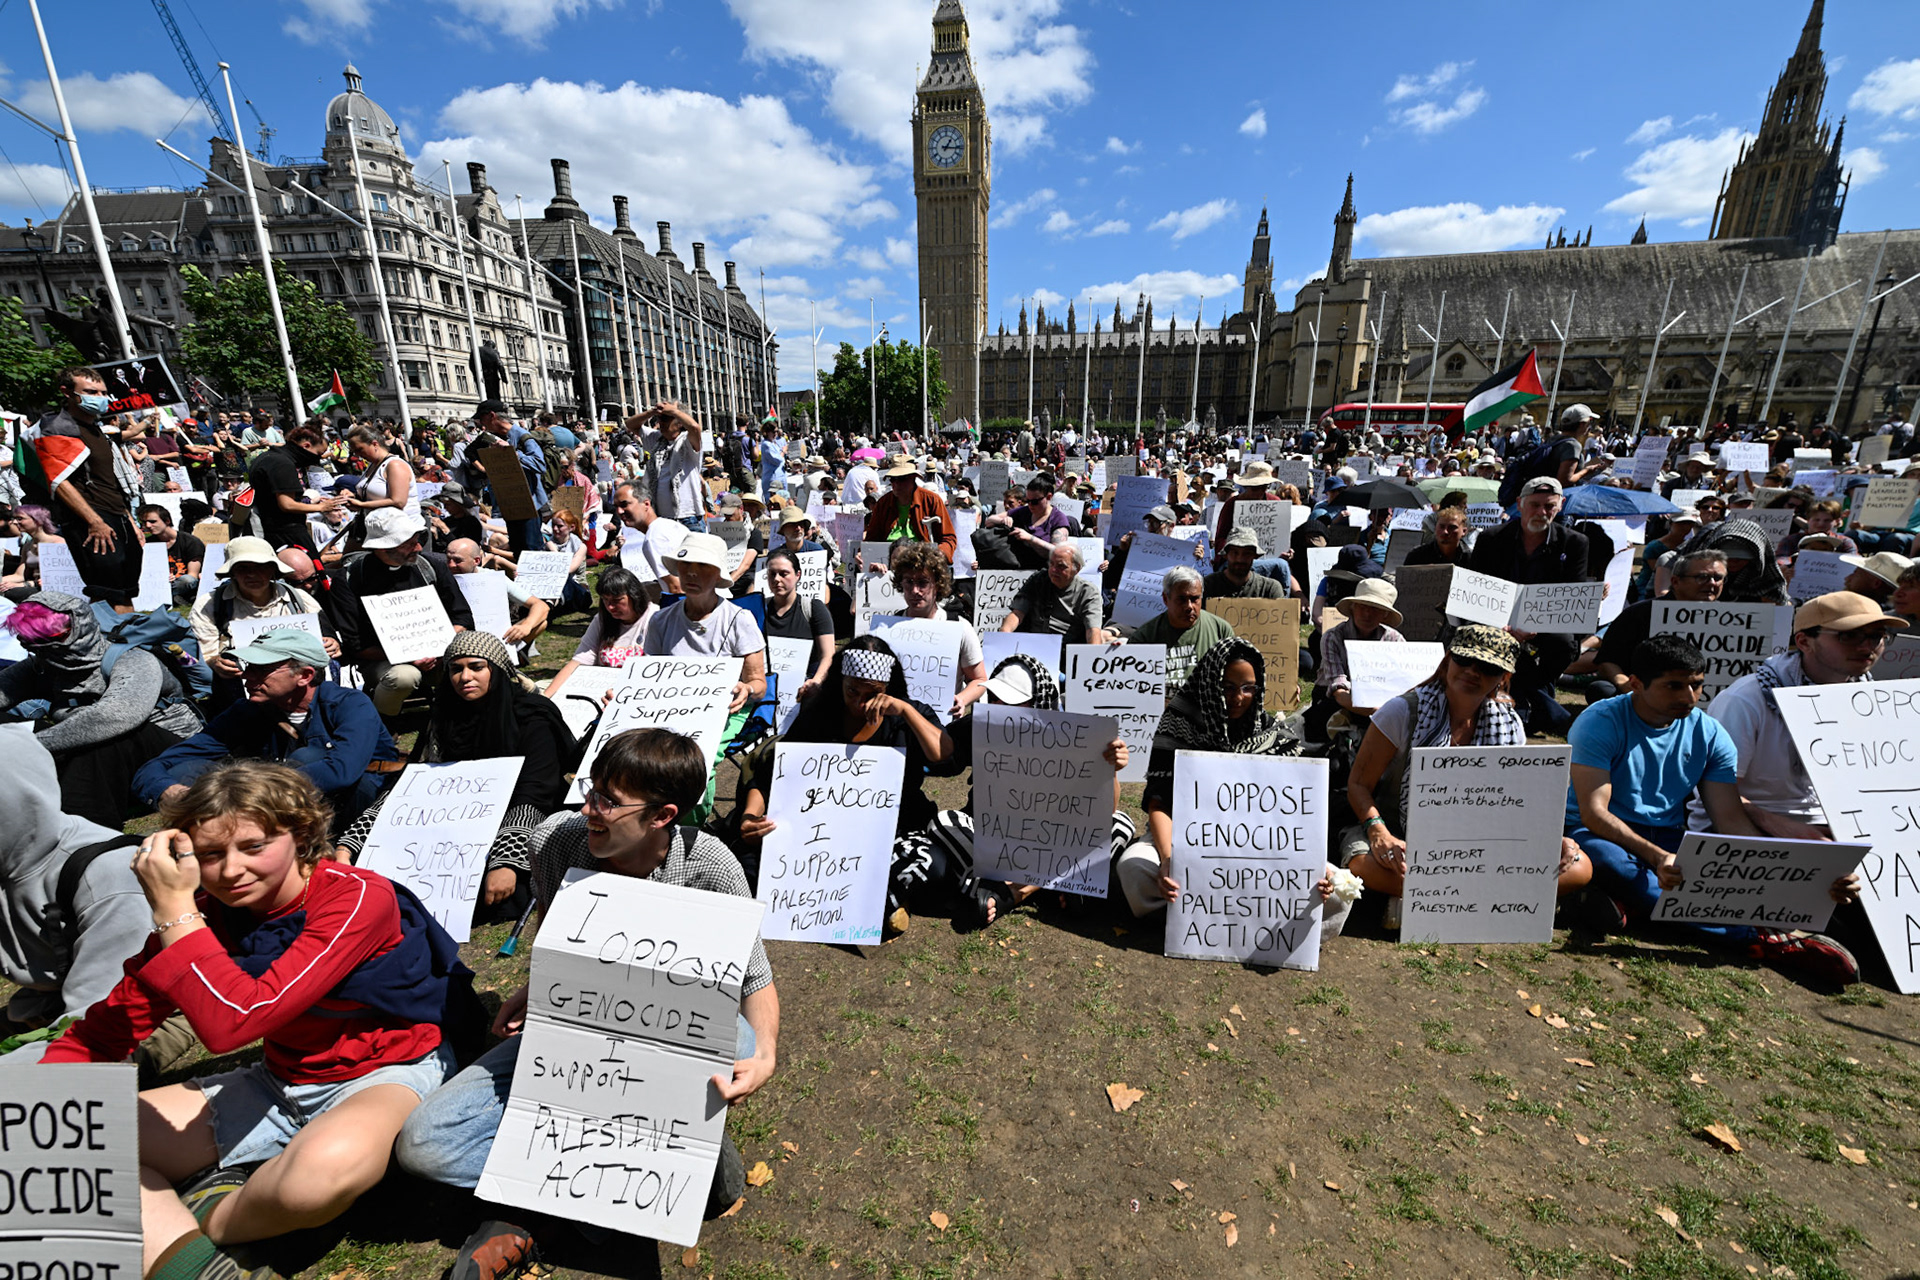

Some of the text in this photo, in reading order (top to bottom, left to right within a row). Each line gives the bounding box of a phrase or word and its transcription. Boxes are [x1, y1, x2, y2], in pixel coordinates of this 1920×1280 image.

[1249, 502, 1278, 515] OPPOSE
[1470, 515, 1499, 524] LESTINE
[1753, 514, 1791, 523] OPPOSE
[1238, 513, 1278, 528] GENOCIDE
[1142, 548, 1187, 562] GENOCIDE
[1145, 538, 1178, 551] OPPOSE
[42, 557, 77, 568] GENOC
[528, 562, 571, 574] GENOCIDE
[534, 554, 569, 563] OPPOSE
[54, 575, 82, 585] SUPPOR
[985, 574, 1026, 592] OPPOS
[1467, 574, 1511, 595] OPPOSE
[380, 592, 424, 609] OPPOSE
[977, 593, 1013, 611] GENO
[1127, 596, 1168, 611] ACTIO
[1449, 586, 1509, 614] GENOCIDE
[1536, 585, 1603, 599] SUPPORT
[1225, 605, 1289, 628] OPPOSE
[1523, 599, 1600, 613] PALESTINE
[391, 616, 438, 633] SUPPORT
[1523, 612, 1587, 626] ACTION
[1662, 606, 1763, 631] I OPPOSE
[889, 627, 946, 646] OPPOSE
[627, 660, 727, 683] I OPPOSE
[901, 653, 952, 678] OCIDE
[1071, 654, 1166, 680] I OPPOSE
[615, 686, 727, 705] GENOCIDE
[908, 683, 946, 701] PORT
[1083, 677, 1164, 696] GENOCIDE
[629, 702, 714, 724] Support
[1796, 692, 1839, 725] I
[985, 710, 1090, 749] I OPPOSE
[983, 750, 1095, 780] GENOCIDE
[1420, 755, 1566, 771] I OPPOSE GENOCIDE
[1808, 737, 1915, 770] GENOC
[775, 752, 878, 781] I OPPOSE
[396, 770, 499, 798] I OPPOSE
[987, 784, 1099, 818] I SUPPORT
[1194, 780, 1315, 816] I OPPOSE
[390, 801, 496, 827] GENOCIDE
[1840, 809, 1872, 839] I
[803, 822, 832, 846] I
[981, 812, 1104, 850] PALESTINE
[1184, 821, 1307, 853] GENOCIDE
[396, 841, 489, 872] SUPPORT
[1413, 848, 1486, 864] I SUPPORT
[1695, 840, 1791, 864] I Oppose
[770, 850, 863, 882] SUPPORT
[1408, 863, 1550, 876] PALESTINE ACTION
[1699, 861, 1822, 883] GENOCIDE
[1184, 866, 1316, 891] I SUPPORT
[1690, 880, 1766, 899] Support
[567, 890, 609, 944] I
[1181, 892, 1310, 922] PALESTINE
[1411, 900, 1540, 915] PALESTINE ACTION
[1660, 897, 1814, 925] Palestine Action
[1182, 921, 1297, 954] ACTION
[598, 931, 743, 1004] OPPOSE
[548, 982, 711, 1040] GENOCIDE
[599, 1036, 626, 1064] I
[0, 1100, 106, 1152] POSE
[526, 1102, 690, 1160] PALESTINE
[537, 1160, 692, 1217] ACTION
